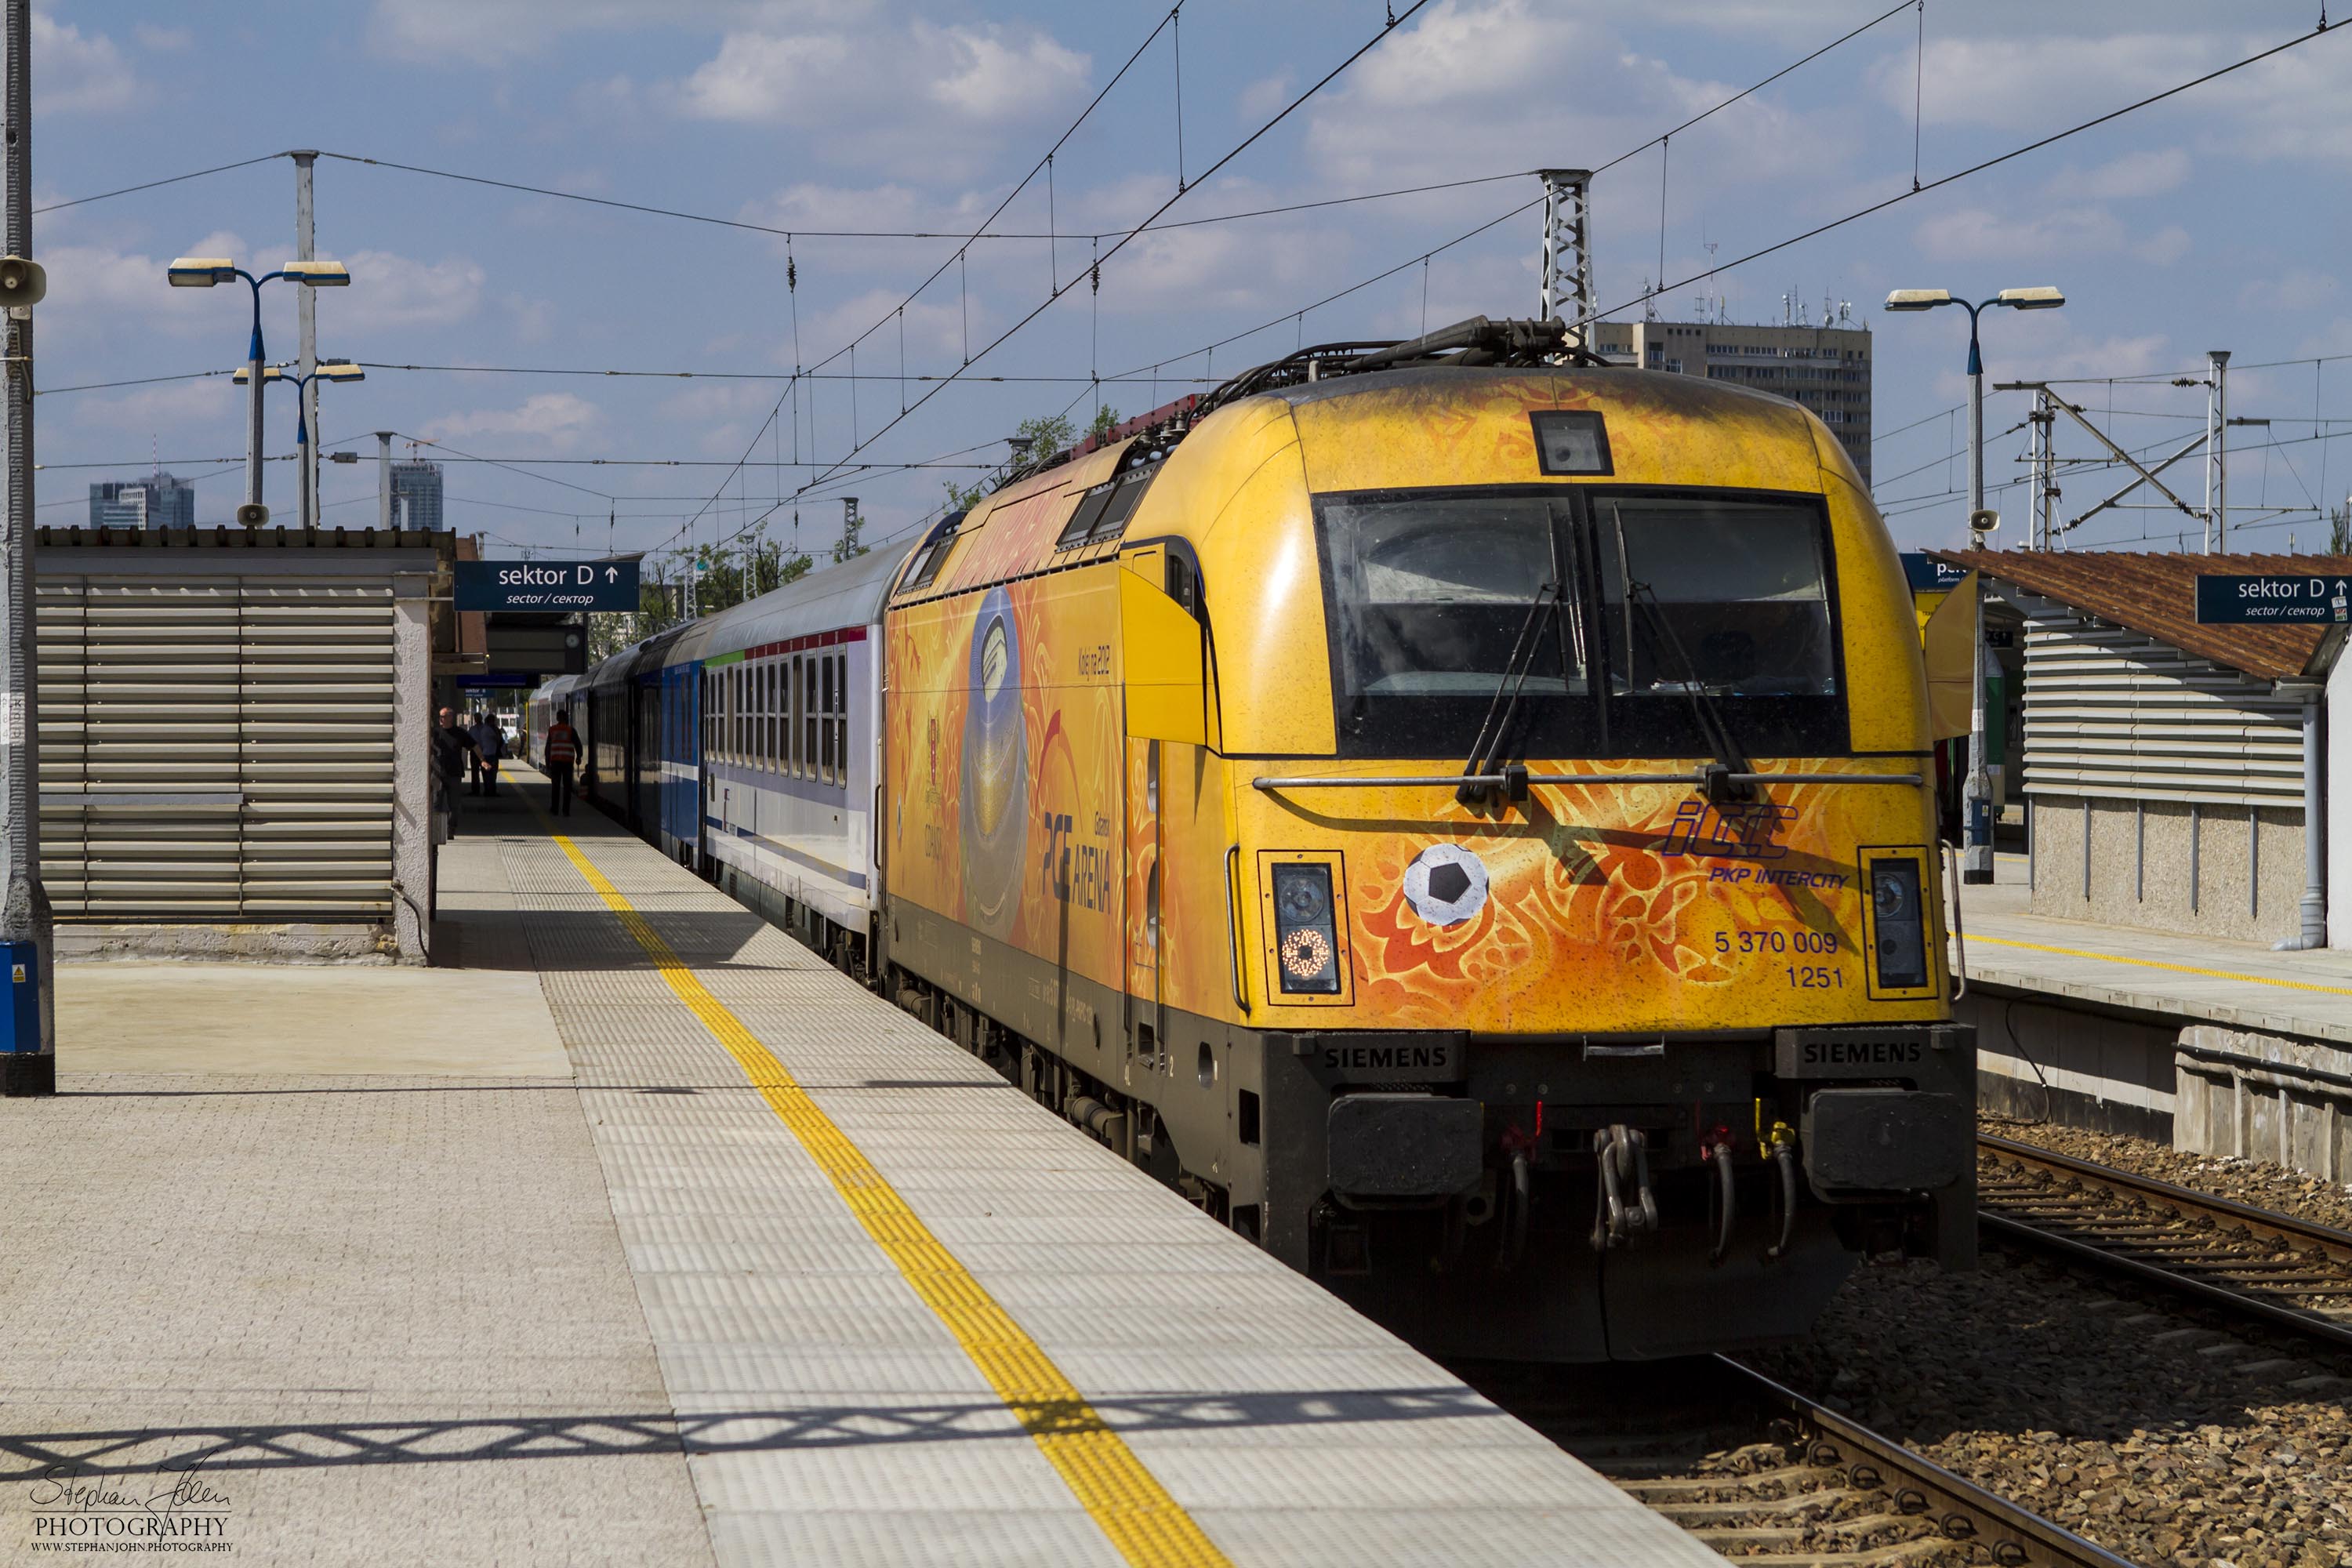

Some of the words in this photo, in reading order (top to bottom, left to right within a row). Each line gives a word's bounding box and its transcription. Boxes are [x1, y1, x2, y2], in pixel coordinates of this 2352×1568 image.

[499, 564, 567, 585] sektor
[577, 565, 593, 585] D
[2238, 578, 2301, 598] sektor
[2310, 579, 2325, 597] D
[506, 593, 543, 604] sector
[552, 594, 594, 606] сектор
[2245, 606, 2278, 616] sector
[2287, 607, 2325, 619] сектор
[1072, 844, 1111, 915] ARENA
[1708, 866, 1751, 884] PKP
[1755, 868, 1850, 890] INTERCITY
[1715, 931, 1730, 953] 5
[1738, 931, 1785, 953] 370
[1793, 931, 1838, 954] 009
[1785, 965, 1842, 988] 1251
[1324, 1047, 1447, 1068] SIEMENS
[1804, 1042, 1921, 1064] SIEMENS
[1169, 1054, 1174, 1078] 2
